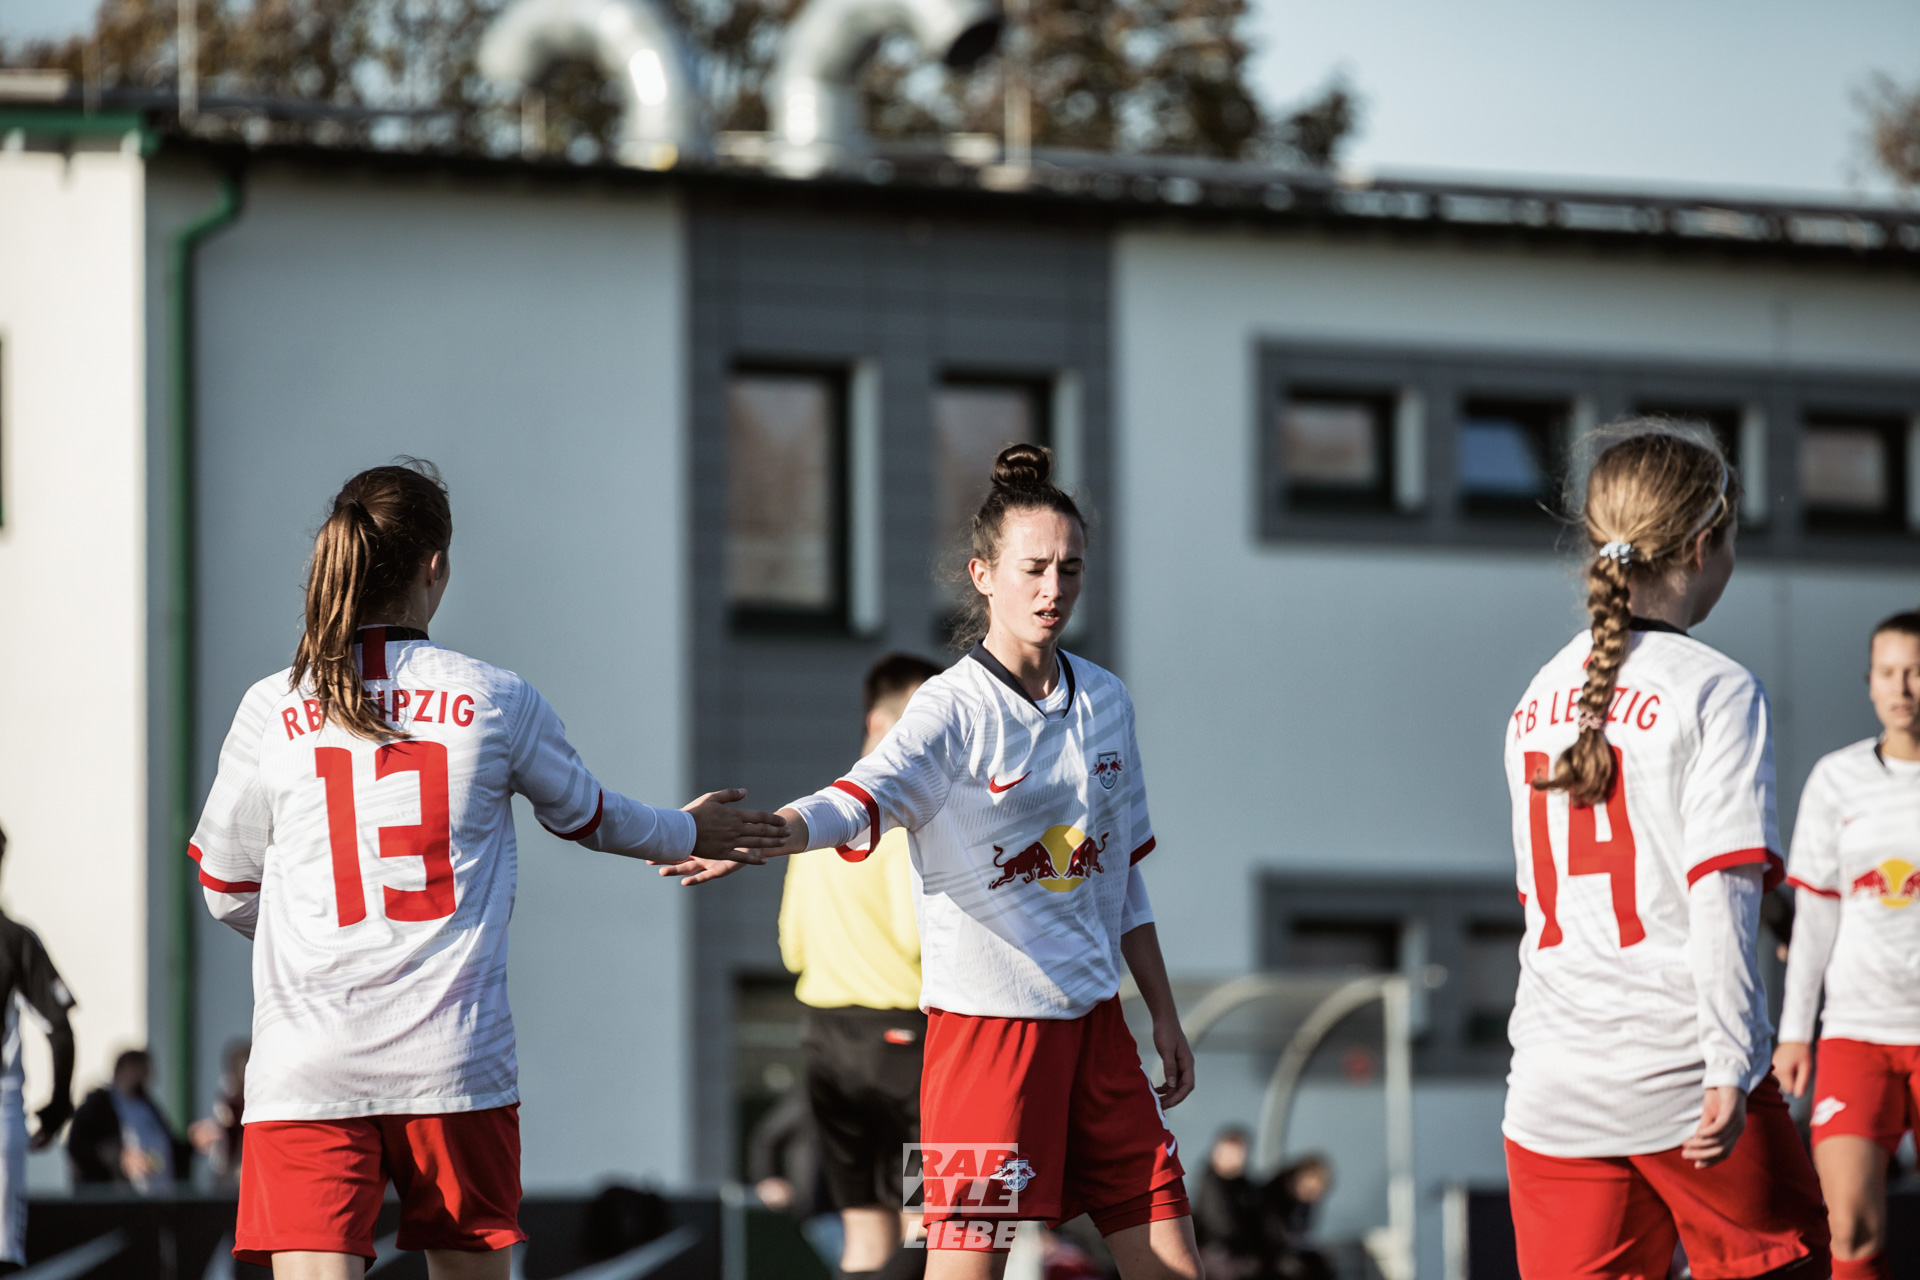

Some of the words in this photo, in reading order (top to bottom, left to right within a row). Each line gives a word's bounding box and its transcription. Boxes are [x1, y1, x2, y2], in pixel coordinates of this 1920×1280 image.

[281, 699, 323, 741] RB
[364, 689, 475, 727] IPZIG
[1550, 686, 1661, 730] LEZIG
[314, 740, 457, 928] 13
[1523, 745, 1647, 950] 14
